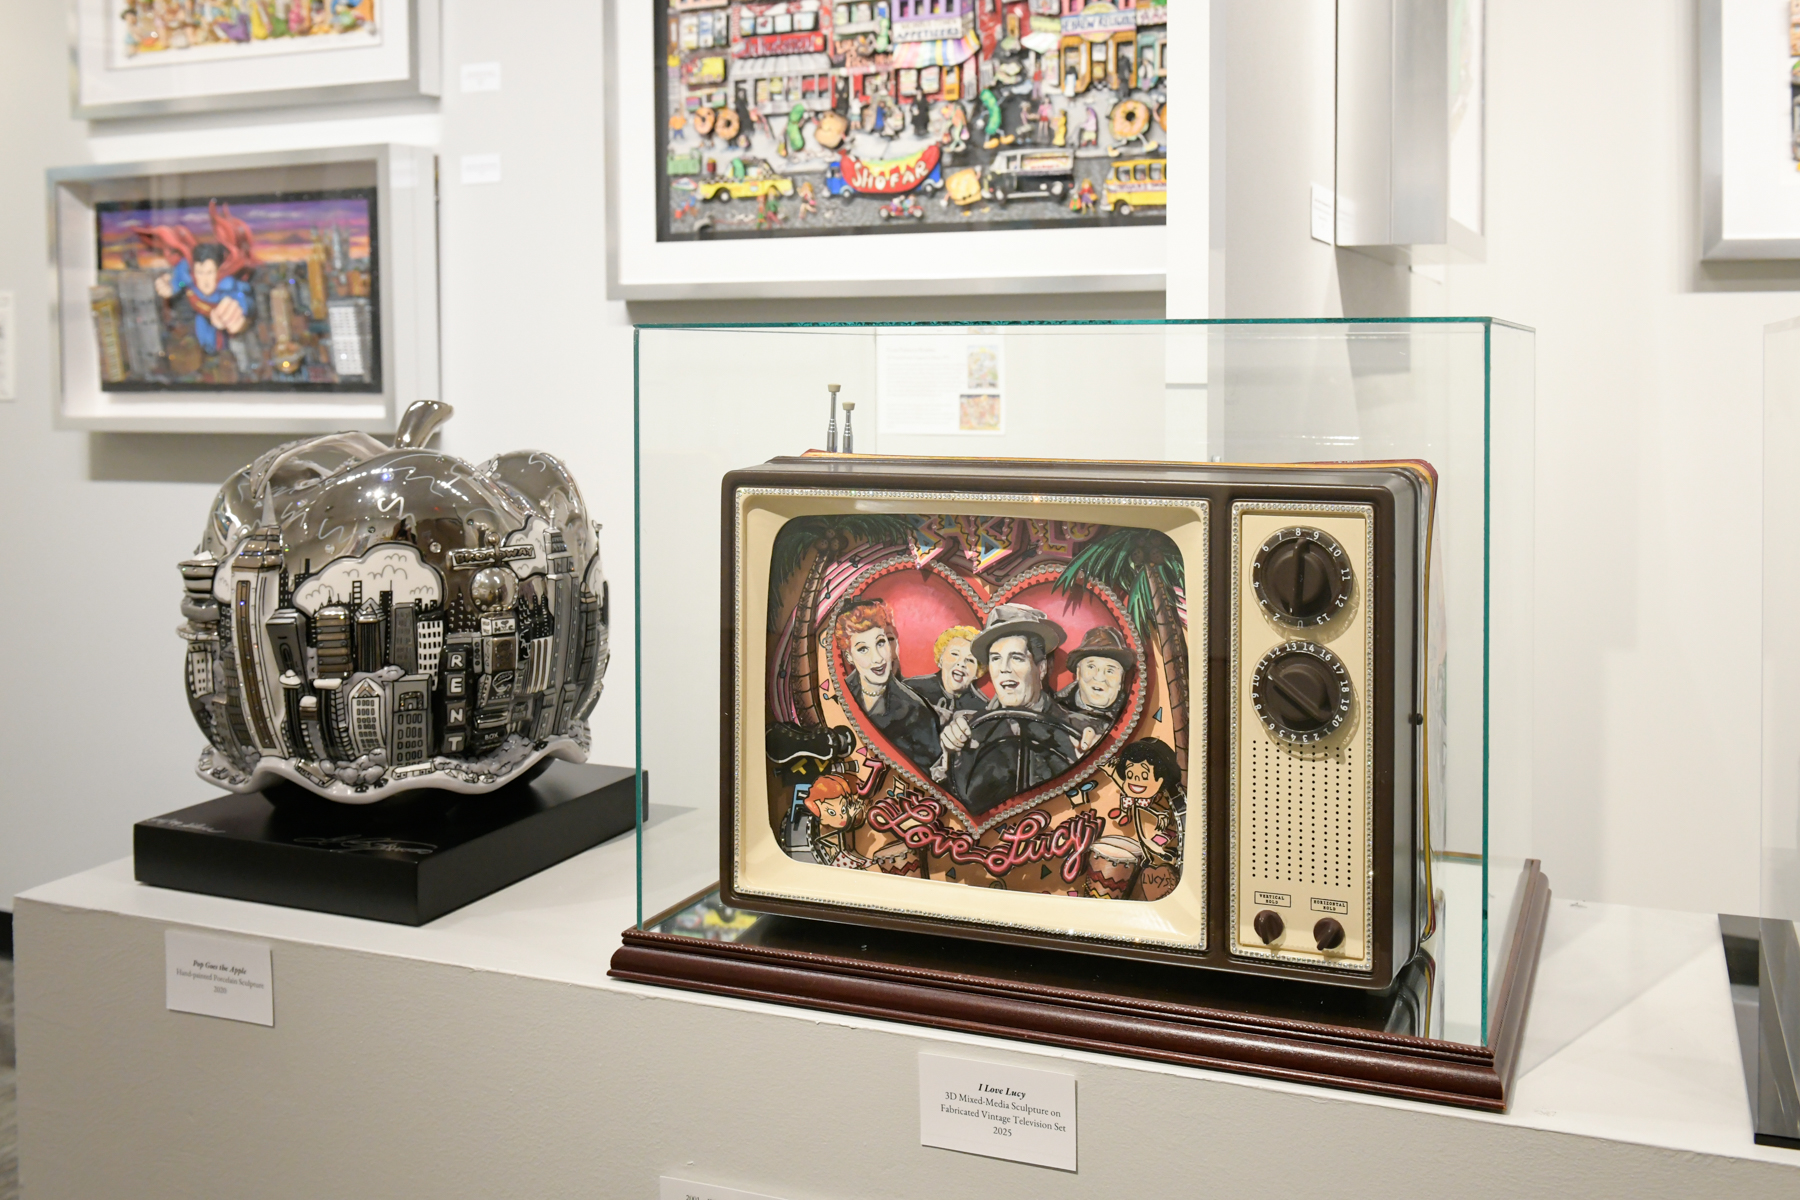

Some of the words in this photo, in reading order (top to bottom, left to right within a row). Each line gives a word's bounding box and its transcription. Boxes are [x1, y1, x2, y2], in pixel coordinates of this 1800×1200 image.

[852, 160, 929, 190] SHOFAR
[454, 548, 534, 564] BROADWAY
[1329, 543, 1342, 557] 10
[1340, 568, 1350, 581] 11
[1335, 594, 1348, 608] 12
[1316, 613, 1330, 625] 13
[1268, 647, 1281, 658] 12
[1285, 643, 1297, 651] 13
[1302, 643, 1315, 652] 14
[1319, 650, 1332, 661] 16
[1258, 659, 1269, 671] 11
[1333, 662, 1344, 674] 17
[1252, 674, 1260, 687] 10
[1340, 680, 1350, 692] 18
[448, 654, 463, 751] RENT
[1340, 698, 1350, 711] 19
[1332, 714, 1343, 727] 20
[485, 732, 498, 740] BOX
[1278, 730, 1285, 738] 5
[1290, 733, 1297, 742] 4
[866, 795, 986, 865] Love
[985, 808, 1103, 884] Lucy
[193, 960, 204, 969] Pop
[205, 962, 218, 970] Goes
[229, 966, 247, 976] Apple
[176, 968, 212, 981] Hand-painted
[213, 974, 238, 985] Porcelain
[239, 979, 264, 989] Sculpture
[978, 1083, 983, 1092] I
[984, 1084, 1004, 1095] Love
[1006, 1088, 1026, 1100] Lucy
[945, 1092, 957, 1100] 3D
[959, 1093, 1010, 1110] Mixed-Media
[1011, 1102, 1049, 1116] Sculpture
[940, 1104, 980, 1118] Fabricated
[981, 1110, 1011, 1125] Vintage
[1013, 1116, 1052, 1130] Television
[1054, 1123, 1066, 1132] Set
[993, 1126, 1013, 1137] 2025
